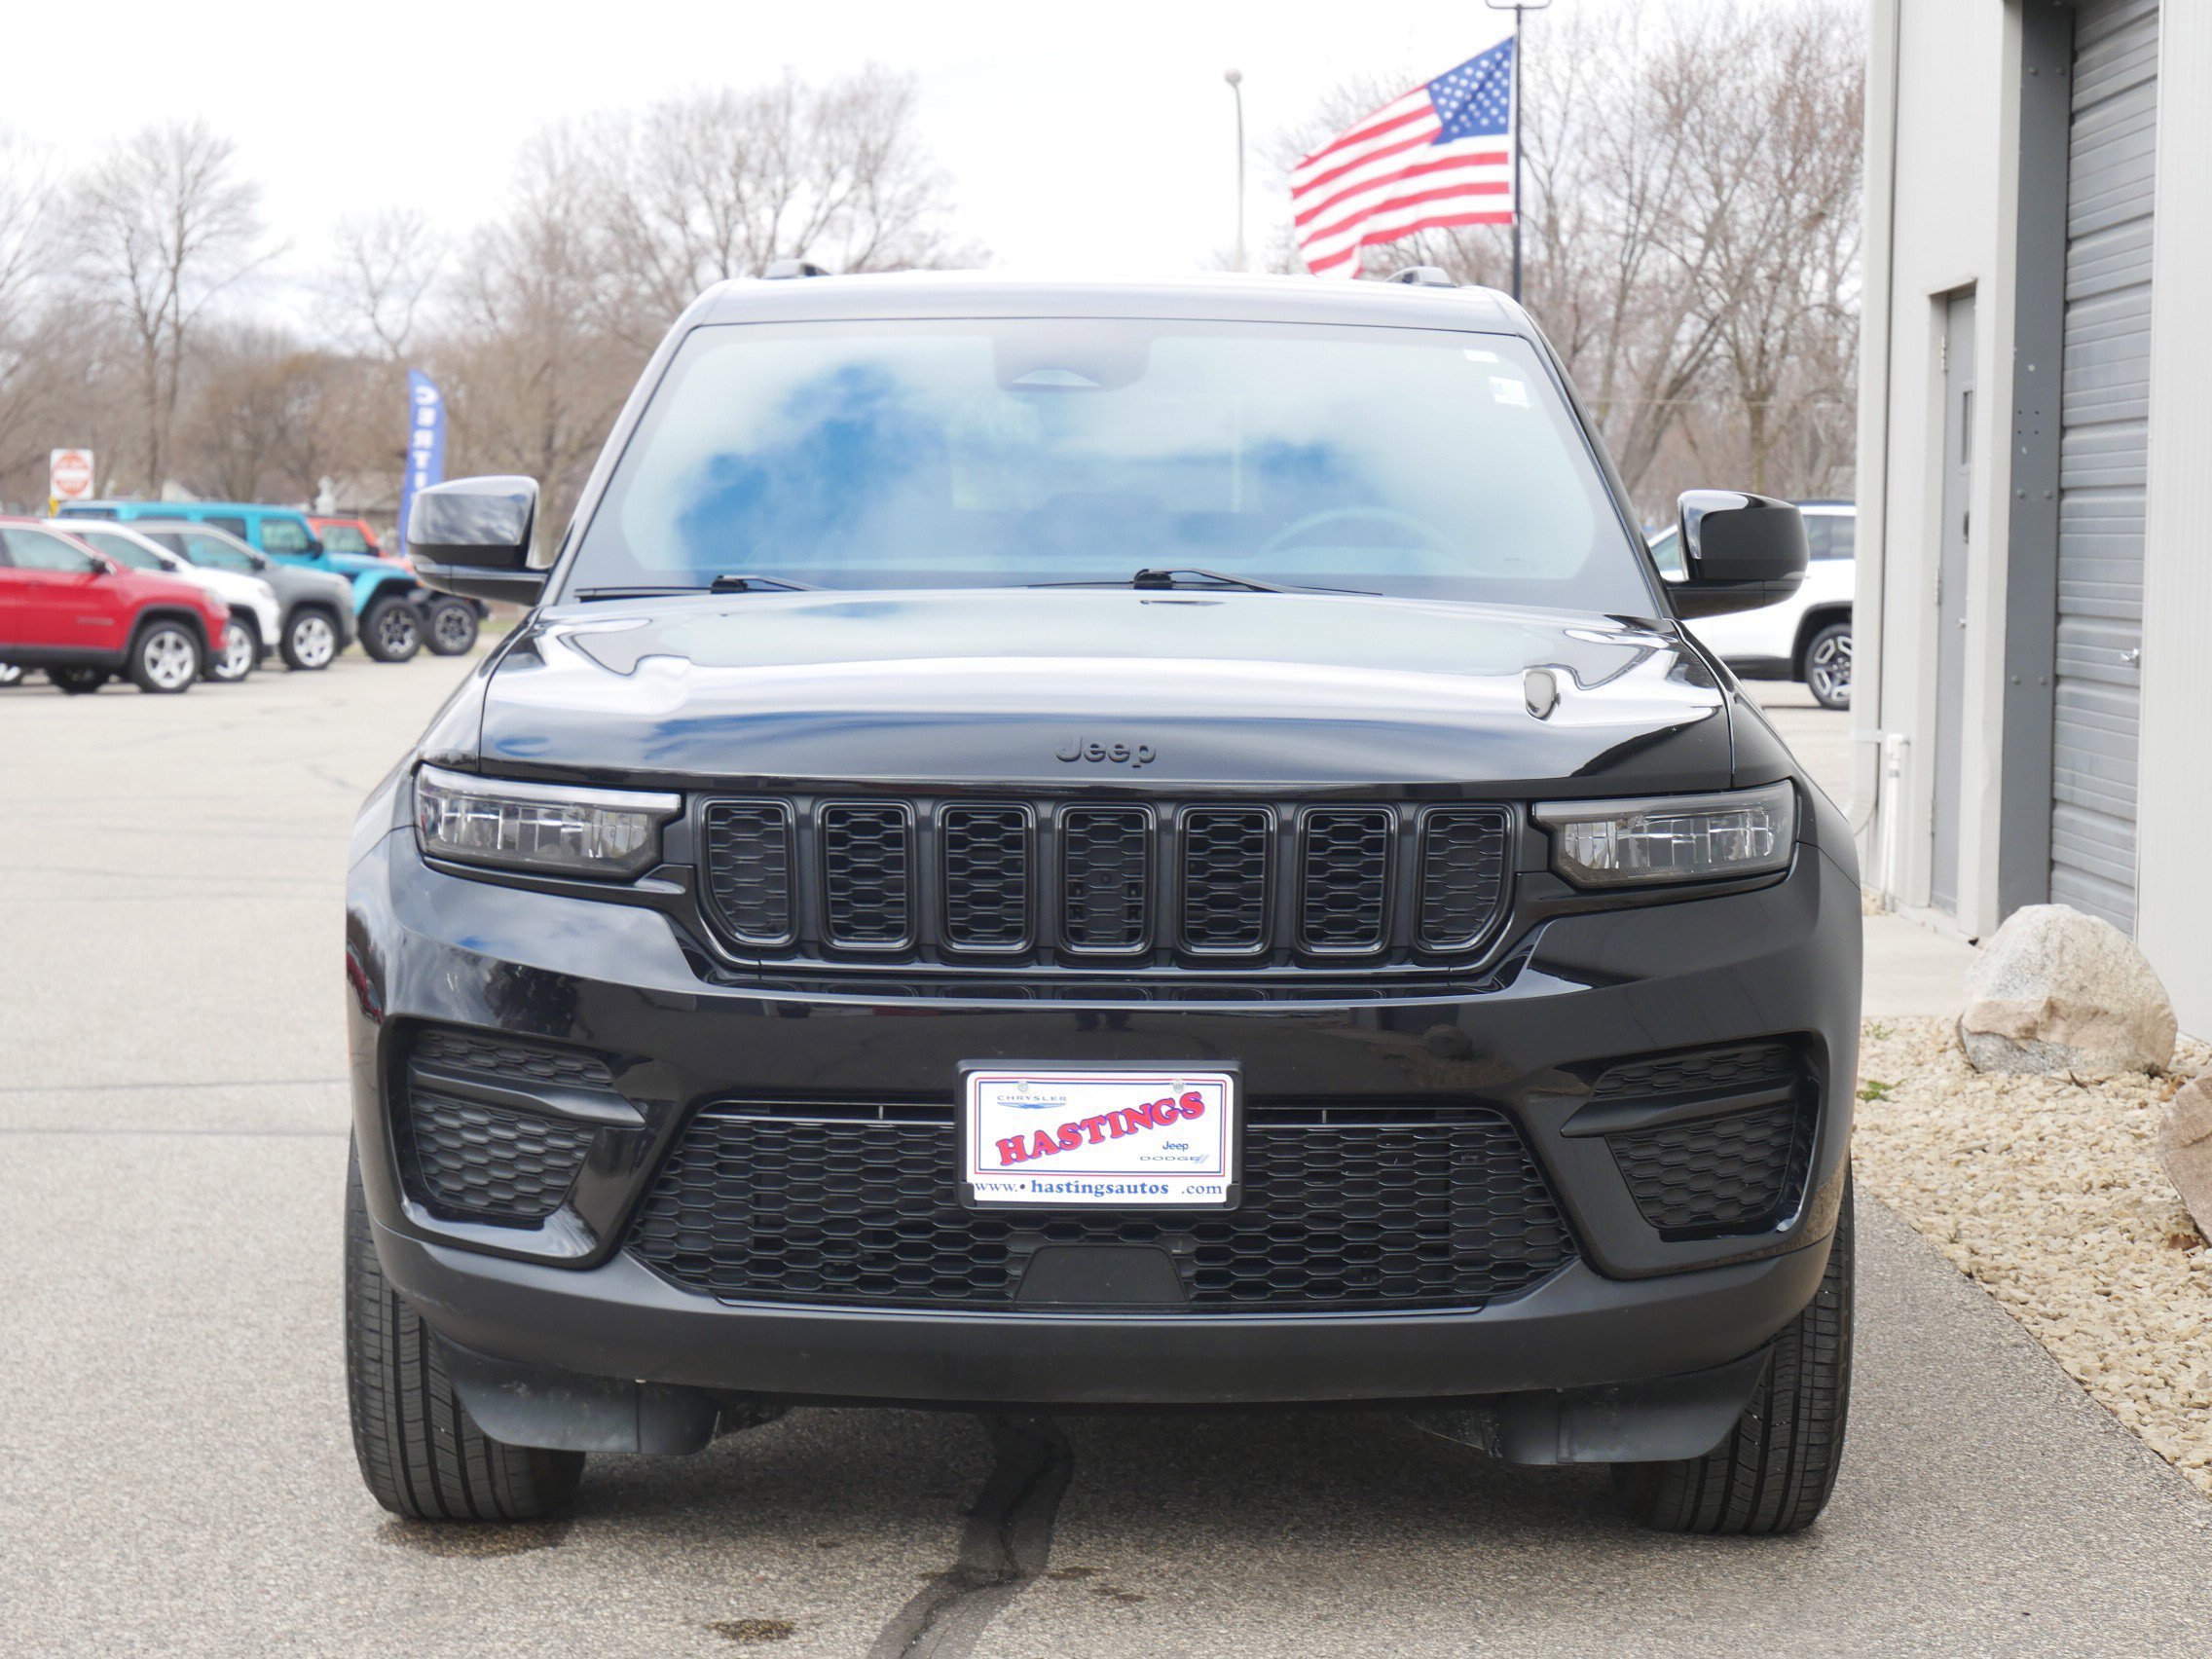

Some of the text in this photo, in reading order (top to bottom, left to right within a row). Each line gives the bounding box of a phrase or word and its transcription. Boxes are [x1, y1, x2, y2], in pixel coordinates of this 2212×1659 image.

[1055, 735, 1157, 768] Jeep
[996, 1091, 1204, 1166] HASTINGS
[1162, 1141, 1189, 1152] Jeep
[1031, 1179, 1168, 1197] hastingsautos
[1181, 1185, 1223, 1195] .com
